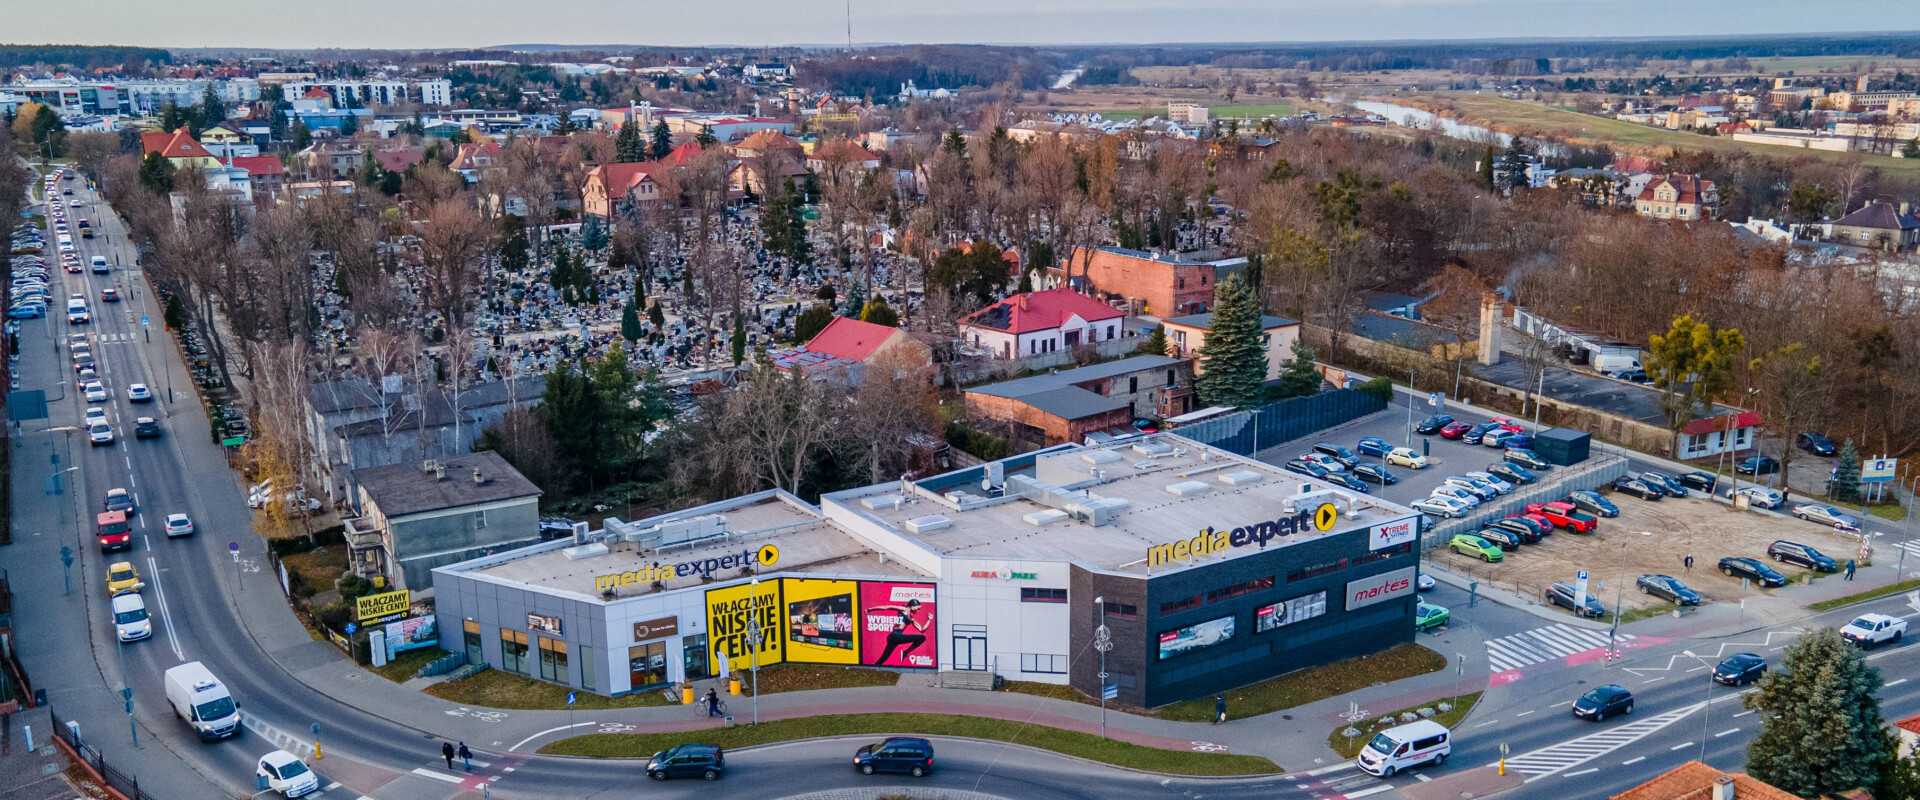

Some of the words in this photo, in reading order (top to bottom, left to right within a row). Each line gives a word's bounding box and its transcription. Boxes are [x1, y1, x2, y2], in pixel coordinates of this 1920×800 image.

[1148, 508, 1310, 567] mediaexpert
[1380, 523, 1409, 538] XTREME
[595, 549, 752, 591] mediaexpert
[1355, 579, 1409, 601] martes
[360, 605, 384, 617] NISKIE
[386, 601, 407, 611] CENY!
[867, 615, 904, 625] WYBIERZ
[867, 624, 894, 632] SPORT
